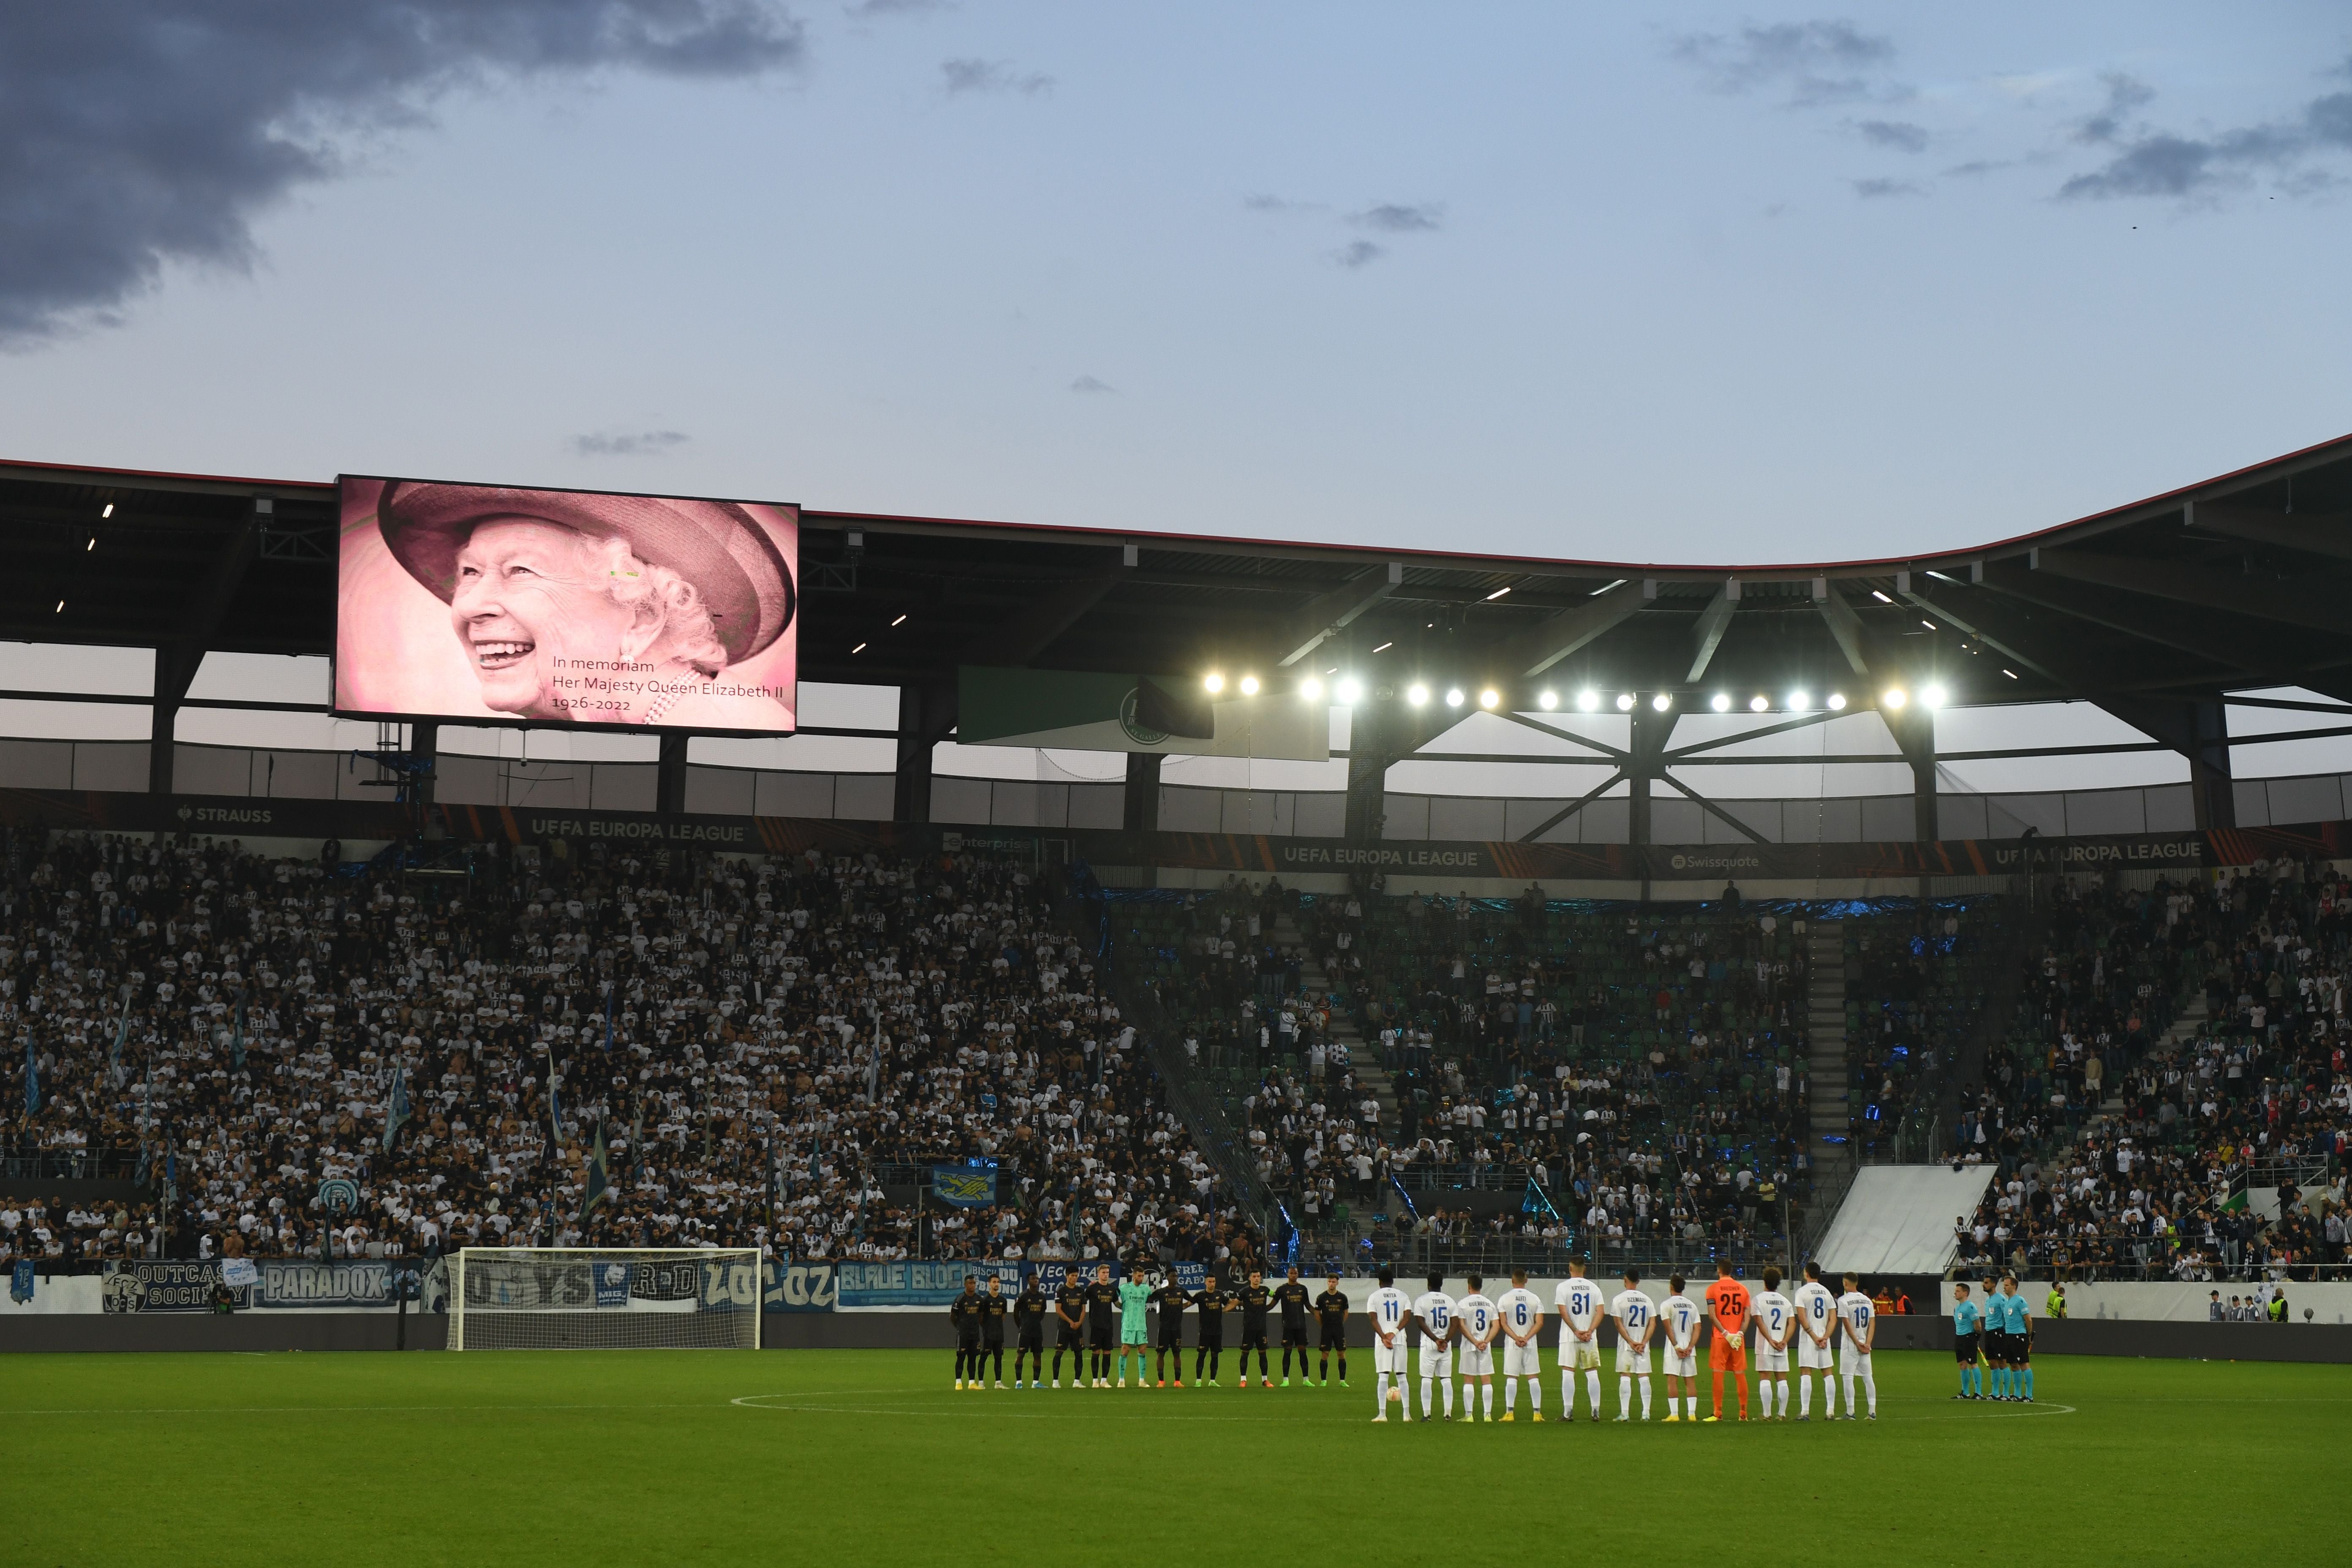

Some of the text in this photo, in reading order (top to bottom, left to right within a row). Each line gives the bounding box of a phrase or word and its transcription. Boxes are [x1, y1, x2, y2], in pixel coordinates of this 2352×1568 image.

[553, 656, 654, 672] In memoriam
[553, 675, 783, 698] Her Majesty Queen Elizabeth II
[552, 697, 630, 711] 1926-2022
[1140, 732, 1165, 740] GALLE
[196, 808, 272, 823] STRAUSS
[532, 819, 743, 841] UEFA EUROPA LEAGUE
[949, 838, 1031, 850] enterprise
[2128, 842, 2201, 859] LEAGUE
[1285, 848, 1477, 866] UEFA EUROPA LEAGUE
[1688, 856, 1759, 869] Swissquote
[840, 1264, 906, 1290] BLAUE
[911, 1263, 972, 1290] BLOCK
[972, 1266, 1018, 1282] BISCH DU
[1175, 1264, 1204, 1274] FREE
[266, 1266, 386, 1300] PARADOX
[1177, 1275, 1205, 1285] GABO
[112, 1298, 136, 1309] OCS
[1383, 1300, 1398, 1321] 11
[1572, 1293, 1590, 1315] 31
[1720, 1293, 1741, 1315] 25
[1814, 1297, 1824, 1319] 8
[1430, 1307, 1447, 1329] 15
[1475, 1309, 1486, 1331] 3
[1516, 1303, 1527, 1326] 6
[1628, 1305, 1646, 1327] 21
[1679, 1311, 1688, 1333] 7
[1771, 1308, 1781, 1330] 2
[1854, 1307, 1869, 1328] 19
